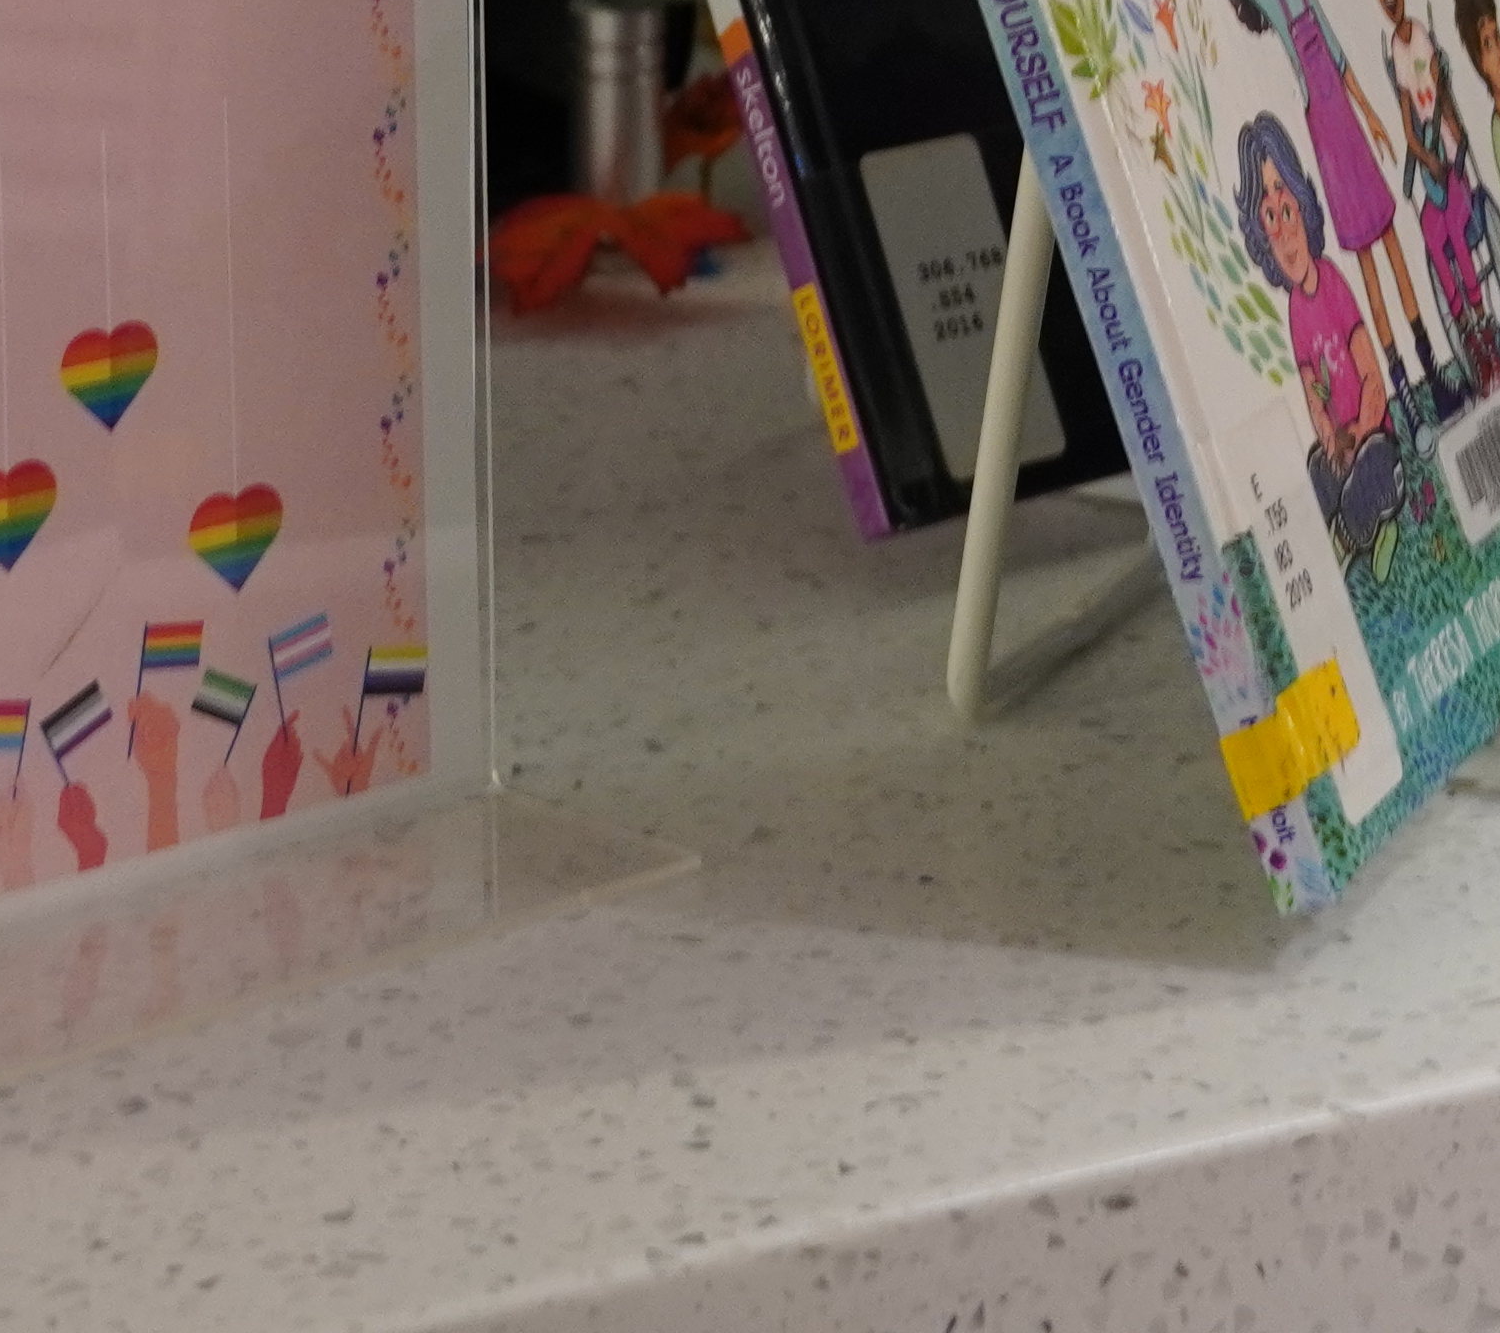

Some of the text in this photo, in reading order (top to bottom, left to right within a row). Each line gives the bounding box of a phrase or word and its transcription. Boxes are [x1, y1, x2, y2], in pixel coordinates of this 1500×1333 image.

[734, 67, 788, 211] skelton
[1048, 151, 1075, 180] A
[1116, 355, 1165, 467] Gender
[1153, 469, 1205, 583] Identity
